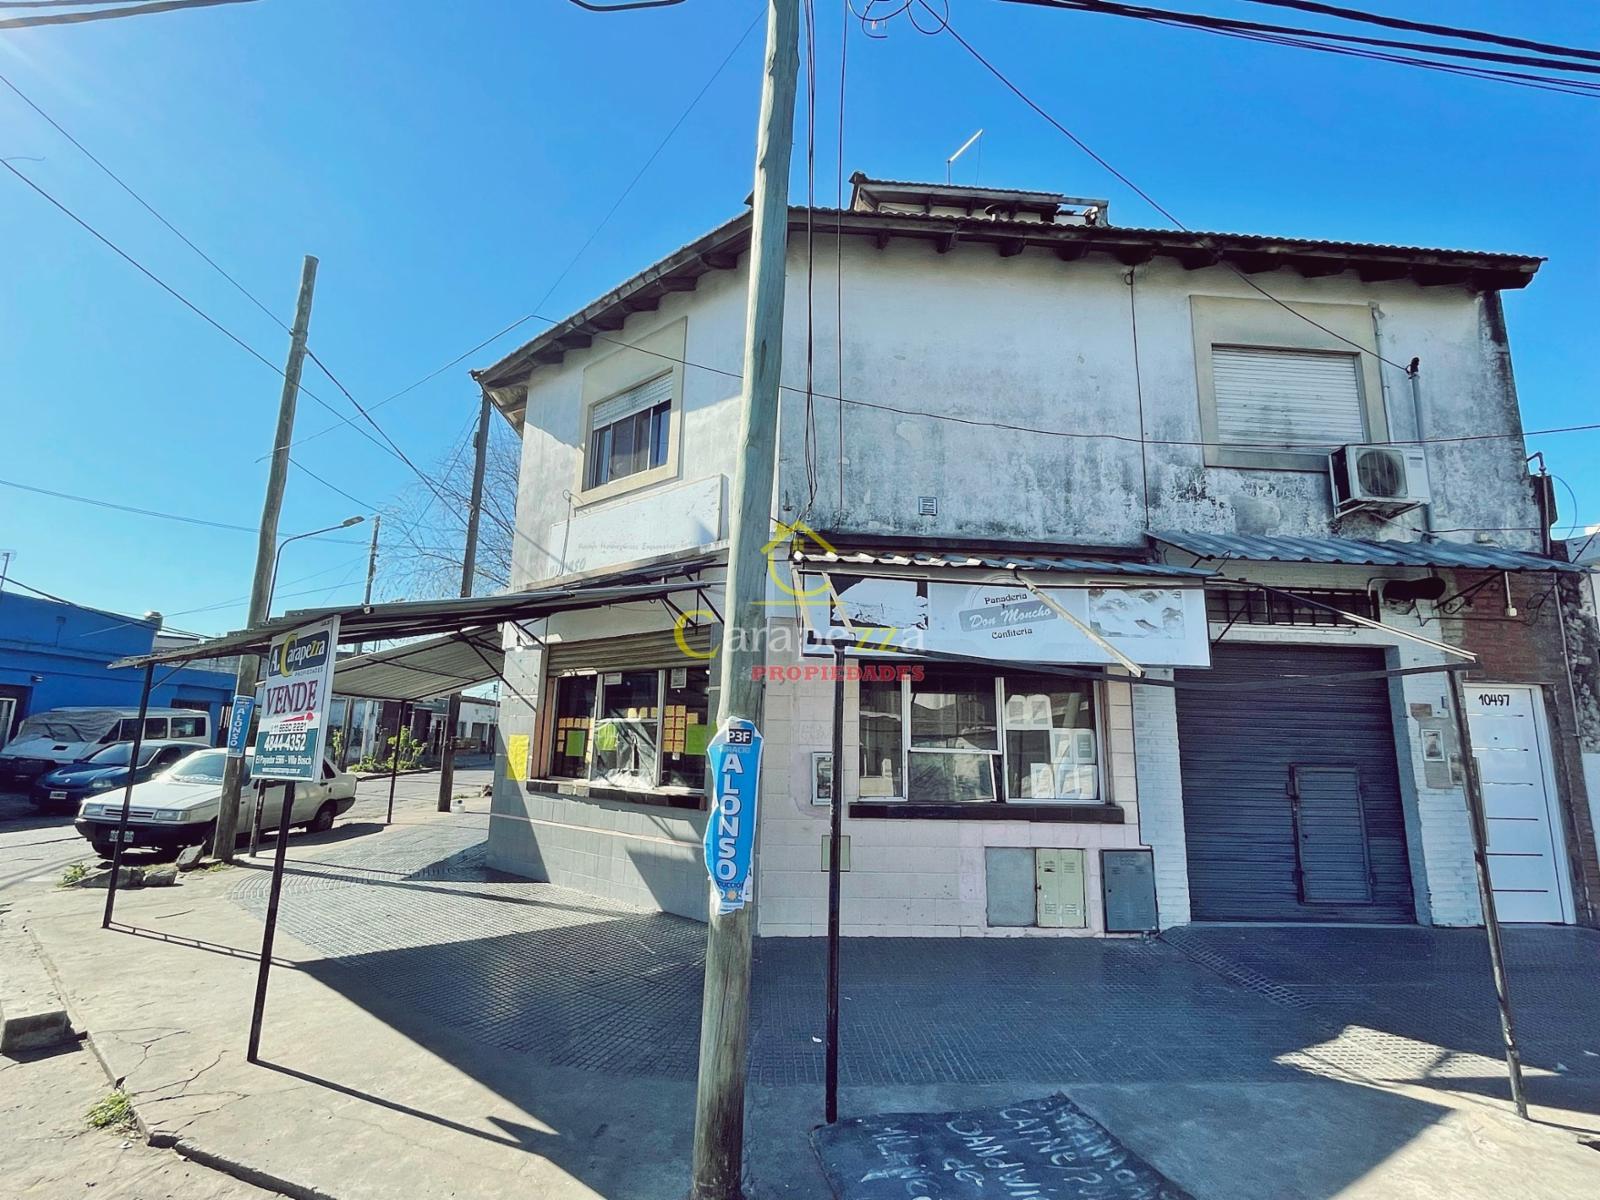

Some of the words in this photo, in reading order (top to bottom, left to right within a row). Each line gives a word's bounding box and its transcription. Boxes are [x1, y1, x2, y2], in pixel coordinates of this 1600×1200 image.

[969, 614, 996, 628] Don
[1000, 605, 1052, 622] Moncho
[282, 633, 325, 677] Carapezza
[267, 681, 318, 715] VENDE
[1478, 693, 1510, 706] 10497
[230, 708, 245, 747] ALONSO
[715, 753, 744, 881] ALONSO
